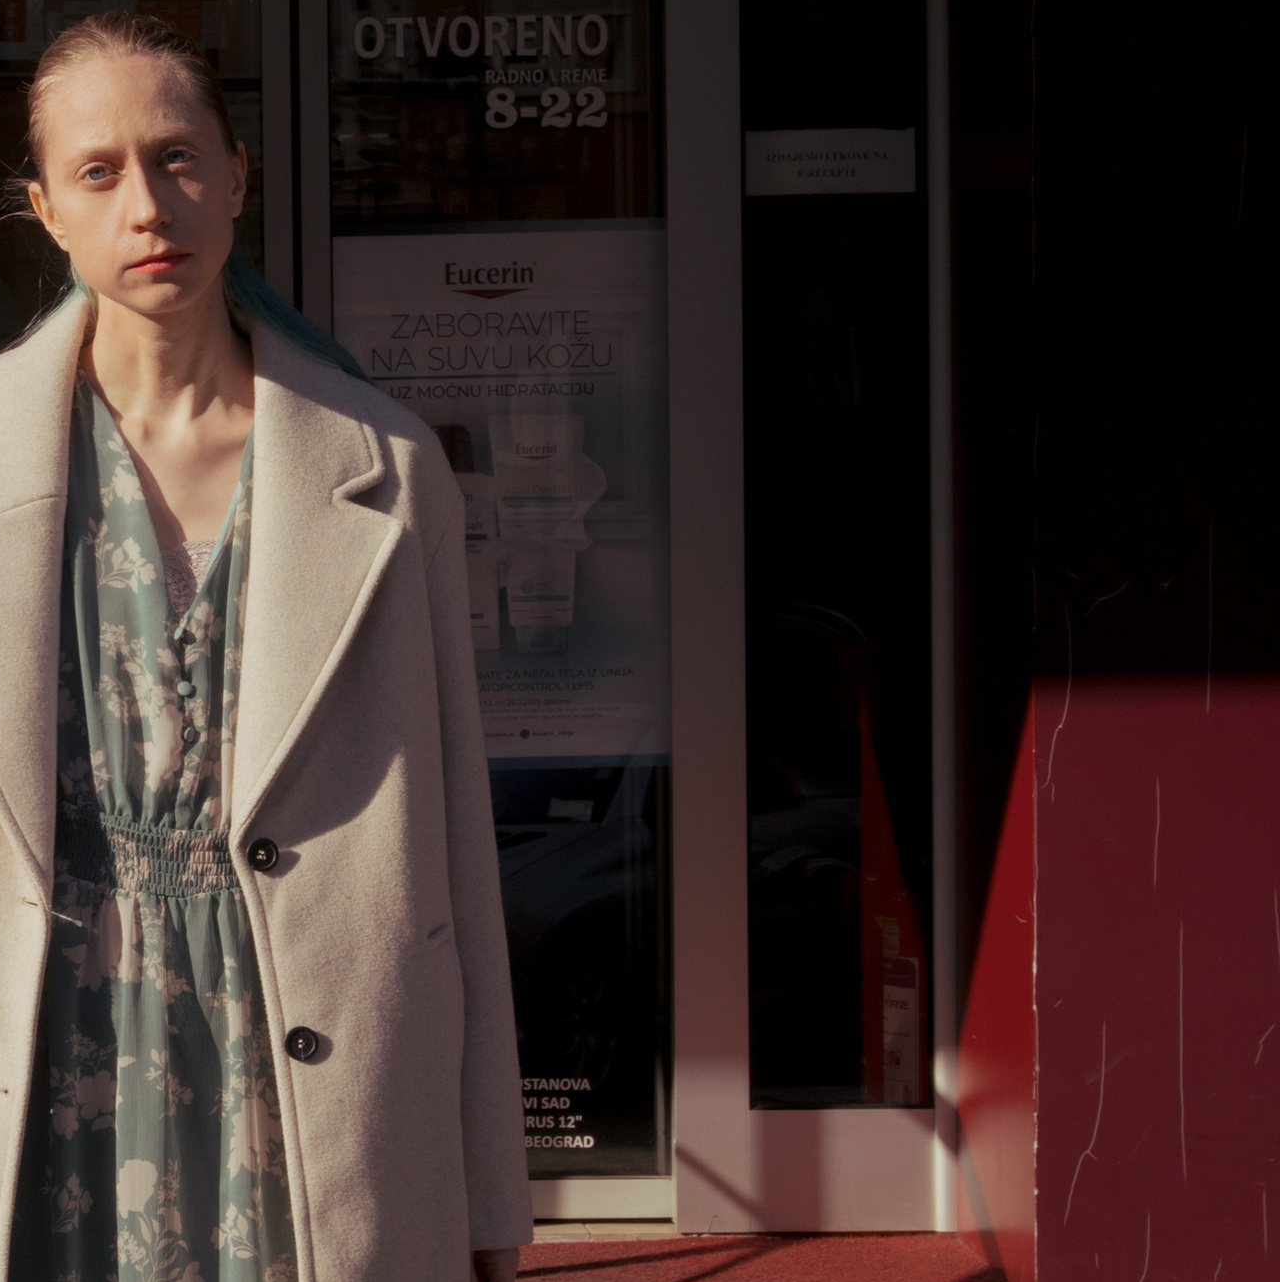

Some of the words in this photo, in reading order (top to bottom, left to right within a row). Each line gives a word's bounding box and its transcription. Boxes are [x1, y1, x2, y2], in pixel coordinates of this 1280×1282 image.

[353, 14, 609, 60] OTVORENO
[484, 68, 545, 85] RADNO
[484, 86, 609, 130] 8-22
[766, 152, 823, 163] IZDAJEMO
[825, 151, 869, 162] LEKOVE
[797, 167, 858, 178] E-RECEPTE
[444, 261, 535, 286] Eucerin
[390, 310, 591, 340] ZABORAVITE
[371, 347, 417, 373] NA
[427, 344, 514, 372] SUVU
[527, 335, 613, 369] KOŽU
[390, 385, 412, 400] UZ
[417, 381, 482, 399] MOĆNU
[487, 381, 596, 398] HIDRATACIJU
[515, 442, 558, 455] Eucerin
[520, 1078, 592, 1091] STANOVA
[541, 1097, 571, 1109] SAD
[558, 1114, 583, 1128] 12"
[524, 1135, 595, 1148] BEOGRAD
